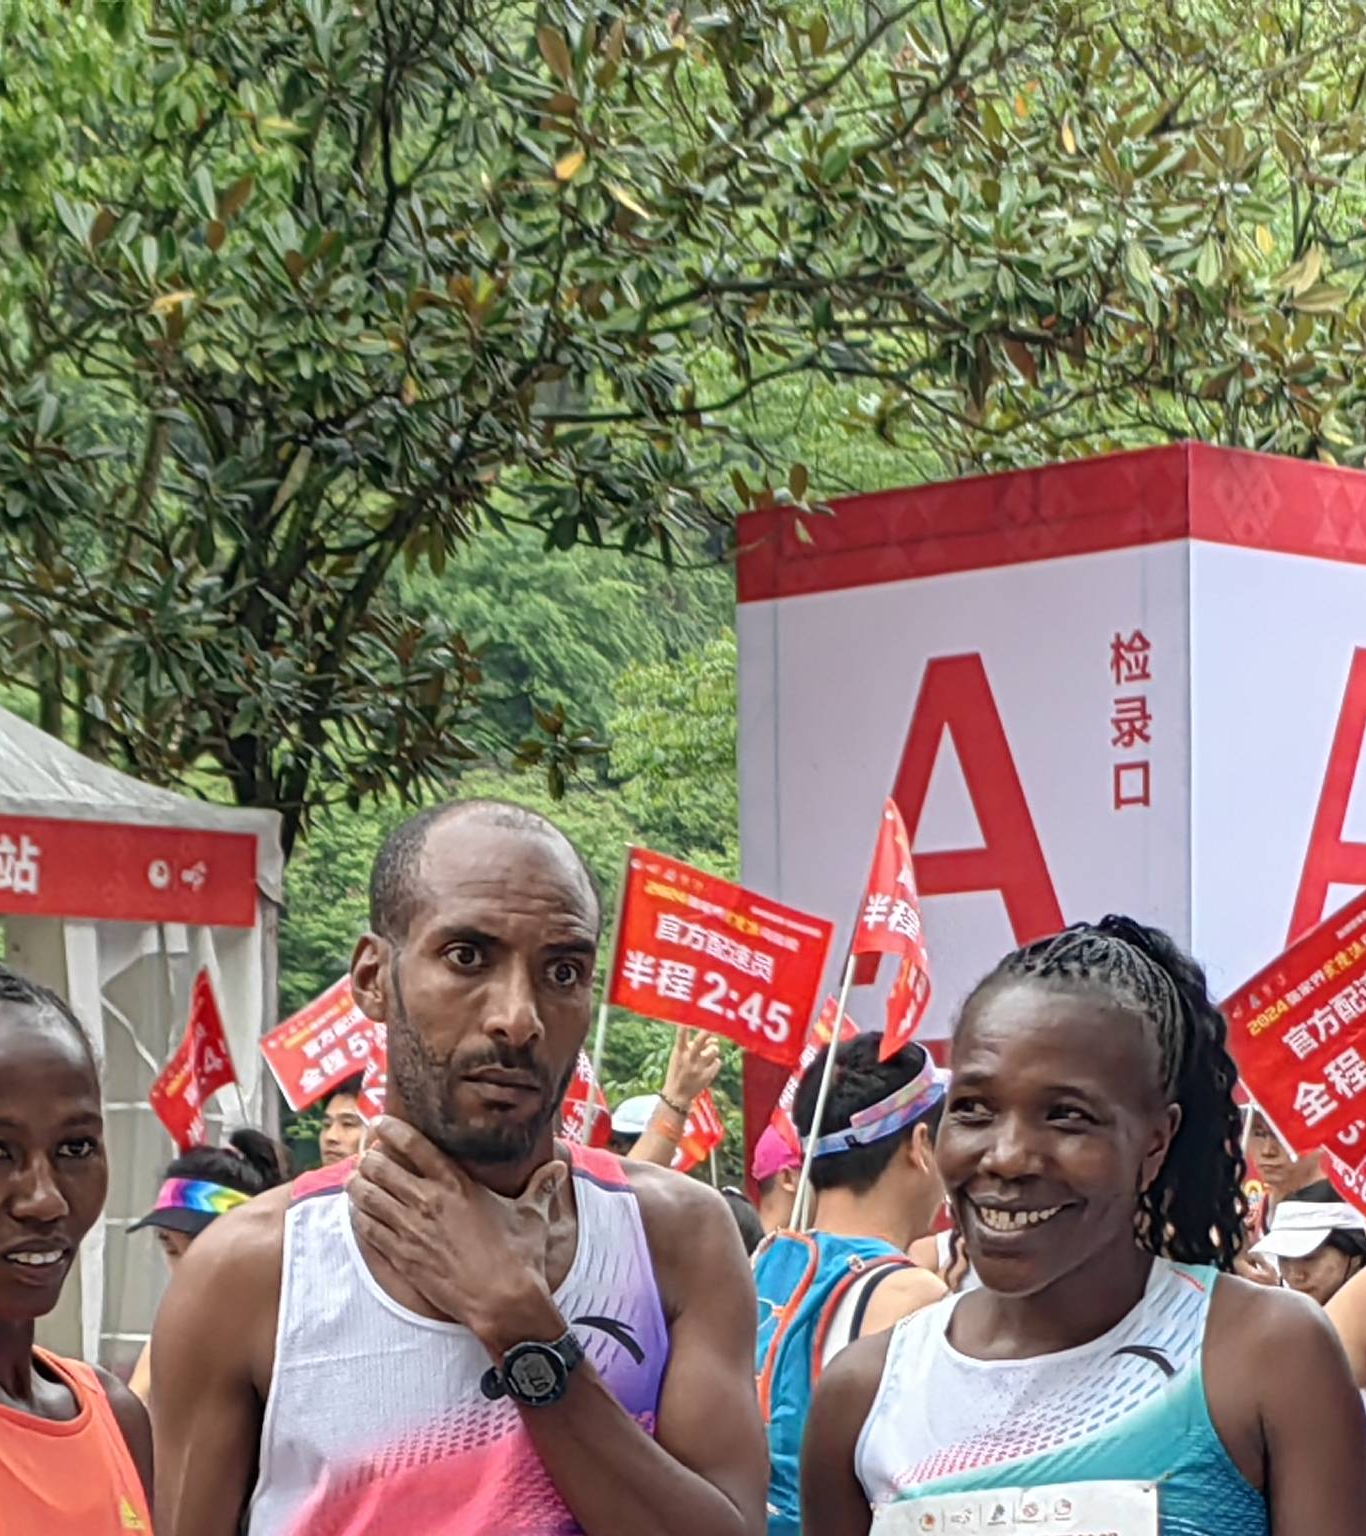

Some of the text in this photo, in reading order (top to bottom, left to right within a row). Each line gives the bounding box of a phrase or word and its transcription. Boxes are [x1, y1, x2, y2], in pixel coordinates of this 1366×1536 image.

[1110, 631, 1152, 809] 检录口
[840, 651, 1068, 987] A
[622, 949, 793, 1043] 半程 2:45
[655, 912, 775, 985] 官方配速员
